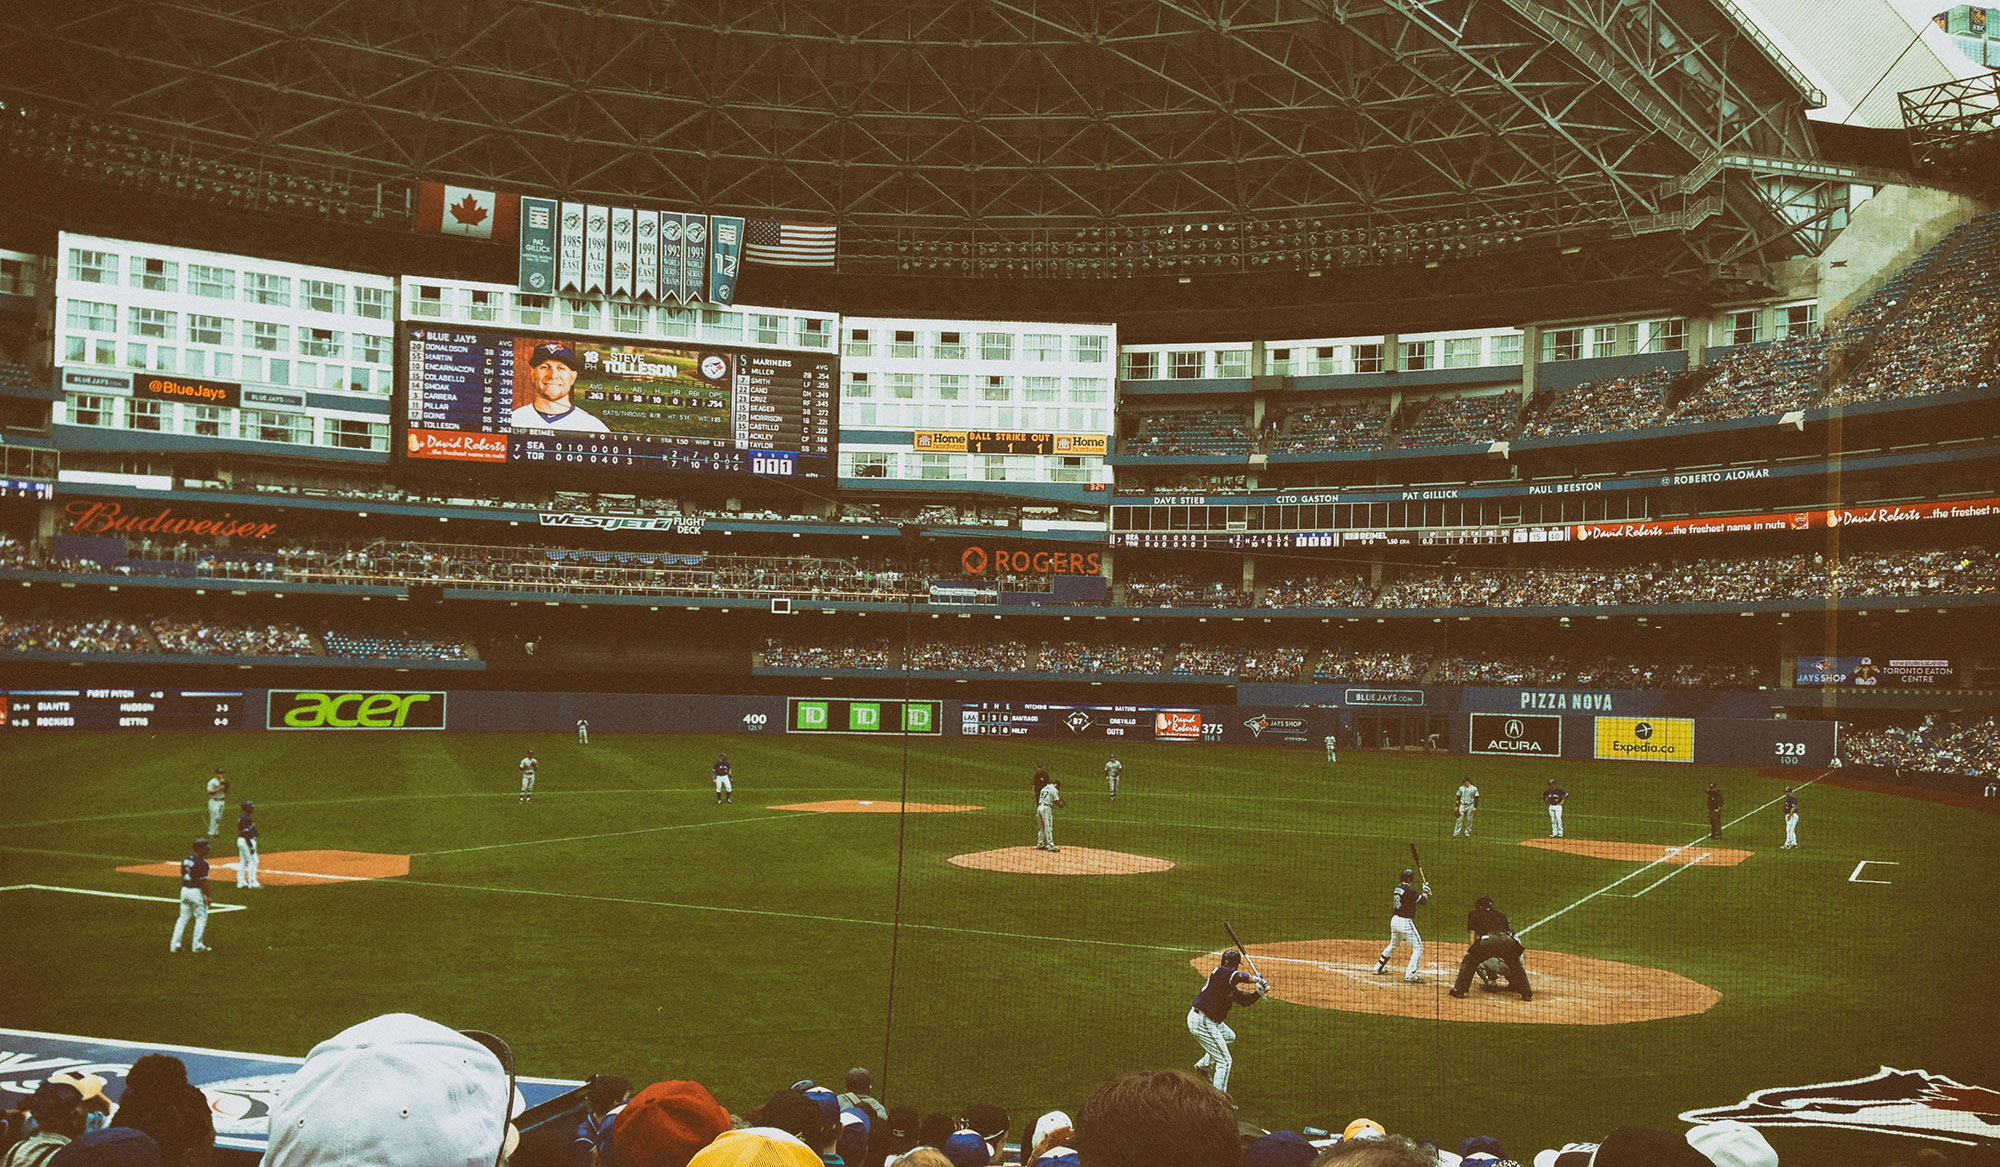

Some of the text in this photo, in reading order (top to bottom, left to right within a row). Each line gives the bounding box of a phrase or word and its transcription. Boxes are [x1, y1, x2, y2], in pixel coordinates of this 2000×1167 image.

[563, 235, 581, 248] 1985
[588, 238, 606, 250] 1989
[614, 240, 630, 253] 1991
[639, 243, 656, 256] 1991
[664, 244, 680, 257] 1992
[687, 246, 704, 259] 1993
[562, 260, 580, 270] EAST
[587, 262, 604, 273] EAST
[715, 253, 737, 277] 12
[638, 268, 655, 277] EAST
[427, 332, 477, 344] BLUE JAYS
[425, 353, 453, 362] MARTIN
[584, 351, 645, 363] 18 STEVE
[584, 363, 597, 371] PH
[753, 358, 792, 368] MARINERS
[602, 360, 678, 378] TOLLESON
[751, 368, 775, 376] MILLER
[424, 382, 450, 391] SMOAK
[750, 377, 771, 385] SMITH
[149, 379, 226, 401] @BlueJays
[750, 386, 768, 394] CANO
[424, 392, 458, 401] CARRERA
[424, 402, 449, 411] PILLAR
[750, 405, 775, 413] SEAGER
[423, 412, 446, 420] GOINS
[423, 421, 460, 430] TOLLESON
[749, 423, 779, 431] CASTILLO
[529, 429, 555, 437] BEIMEL
[749, 432, 774, 440] ACKLEY
[970, 432, 1050, 442] BALL STRIKE OUT
[427, 434, 505, 452] David Roberts
[933, 433, 966, 445] Home
[1072, 436, 1105, 447] Home
[527, 441, 545, 450] SEA
[556, 443, 562, 451] 0
[577, 444, 583, 452] 0
[591, 445, 597, 453] 0
[749, 441, 774, 449] TAYLOR
[976, 442, 1043, 454] 1 1 1
[526, 452, 544, 460] TOR
[555, 453, 562, 461] 0
[567, 454, 573, 462] 0
[591, 455, 597, 463] 0
[1674, 468, 1770, 485] ROBERTO ALOMAR
[1529, 482, 1602, 495] PAUL BEESTON
[1276, 495, 1339, 504] CITO GASTON
[1402, 489, 1458, 500] PAT GILLICK
[1154, 497, 1176, 505] DAVE
[66, 501, 277, 538] Budweiser
[541, 513, 652, 529] WESTJET
[1843, 510, 1877, 526] David
[1878, 508, 1920, 523] Roberts
[1950, 506, 1990, 518] freshest
[673, 517, 706, 527] FLIGHT
[677, 526, 701, 535] DECK
[1593, 525, 1624, 539] David
[1625, 525, 1663, 538] Roberts
[1688, 523, 1725, 534] freshest
[1726, 523, 1752, 532] name
[1754, 522, 1763, 530] in
[1765, 521, 1786, 530] nuts
[995, 550, 1100, 574] ROGERS
[1883, 667, 1953, 675] TORONTO EATON
[1797, 674, 1847, 683] JAYS SHOP
[1901, 675, 1934, 683] CENTRE
[86, 689, 110, 699] FIRST
[110, 689, 135, 698] PITCH
[37, 702, 70, 712] GIANTS
[1520, 692, 1613, 712] PIZZA NOVA
[284, 693, 431, 727] acer
[800, 706, 826, 724] TD
[743, 714, 767, 724] 400
[853, 707, 877, 725] TD
[908, 708, 929, 726] TD
[1106, 728, 1125, 736] OUTS
[1201, 724, 1223, 734] 375
[1487, 739, 1542, 752] ACURA
[1613, 740, 1675, 756] Expedia.co
[1774, 742, 1806, 756] 328
[1780, 756, 1799, 765] 100
